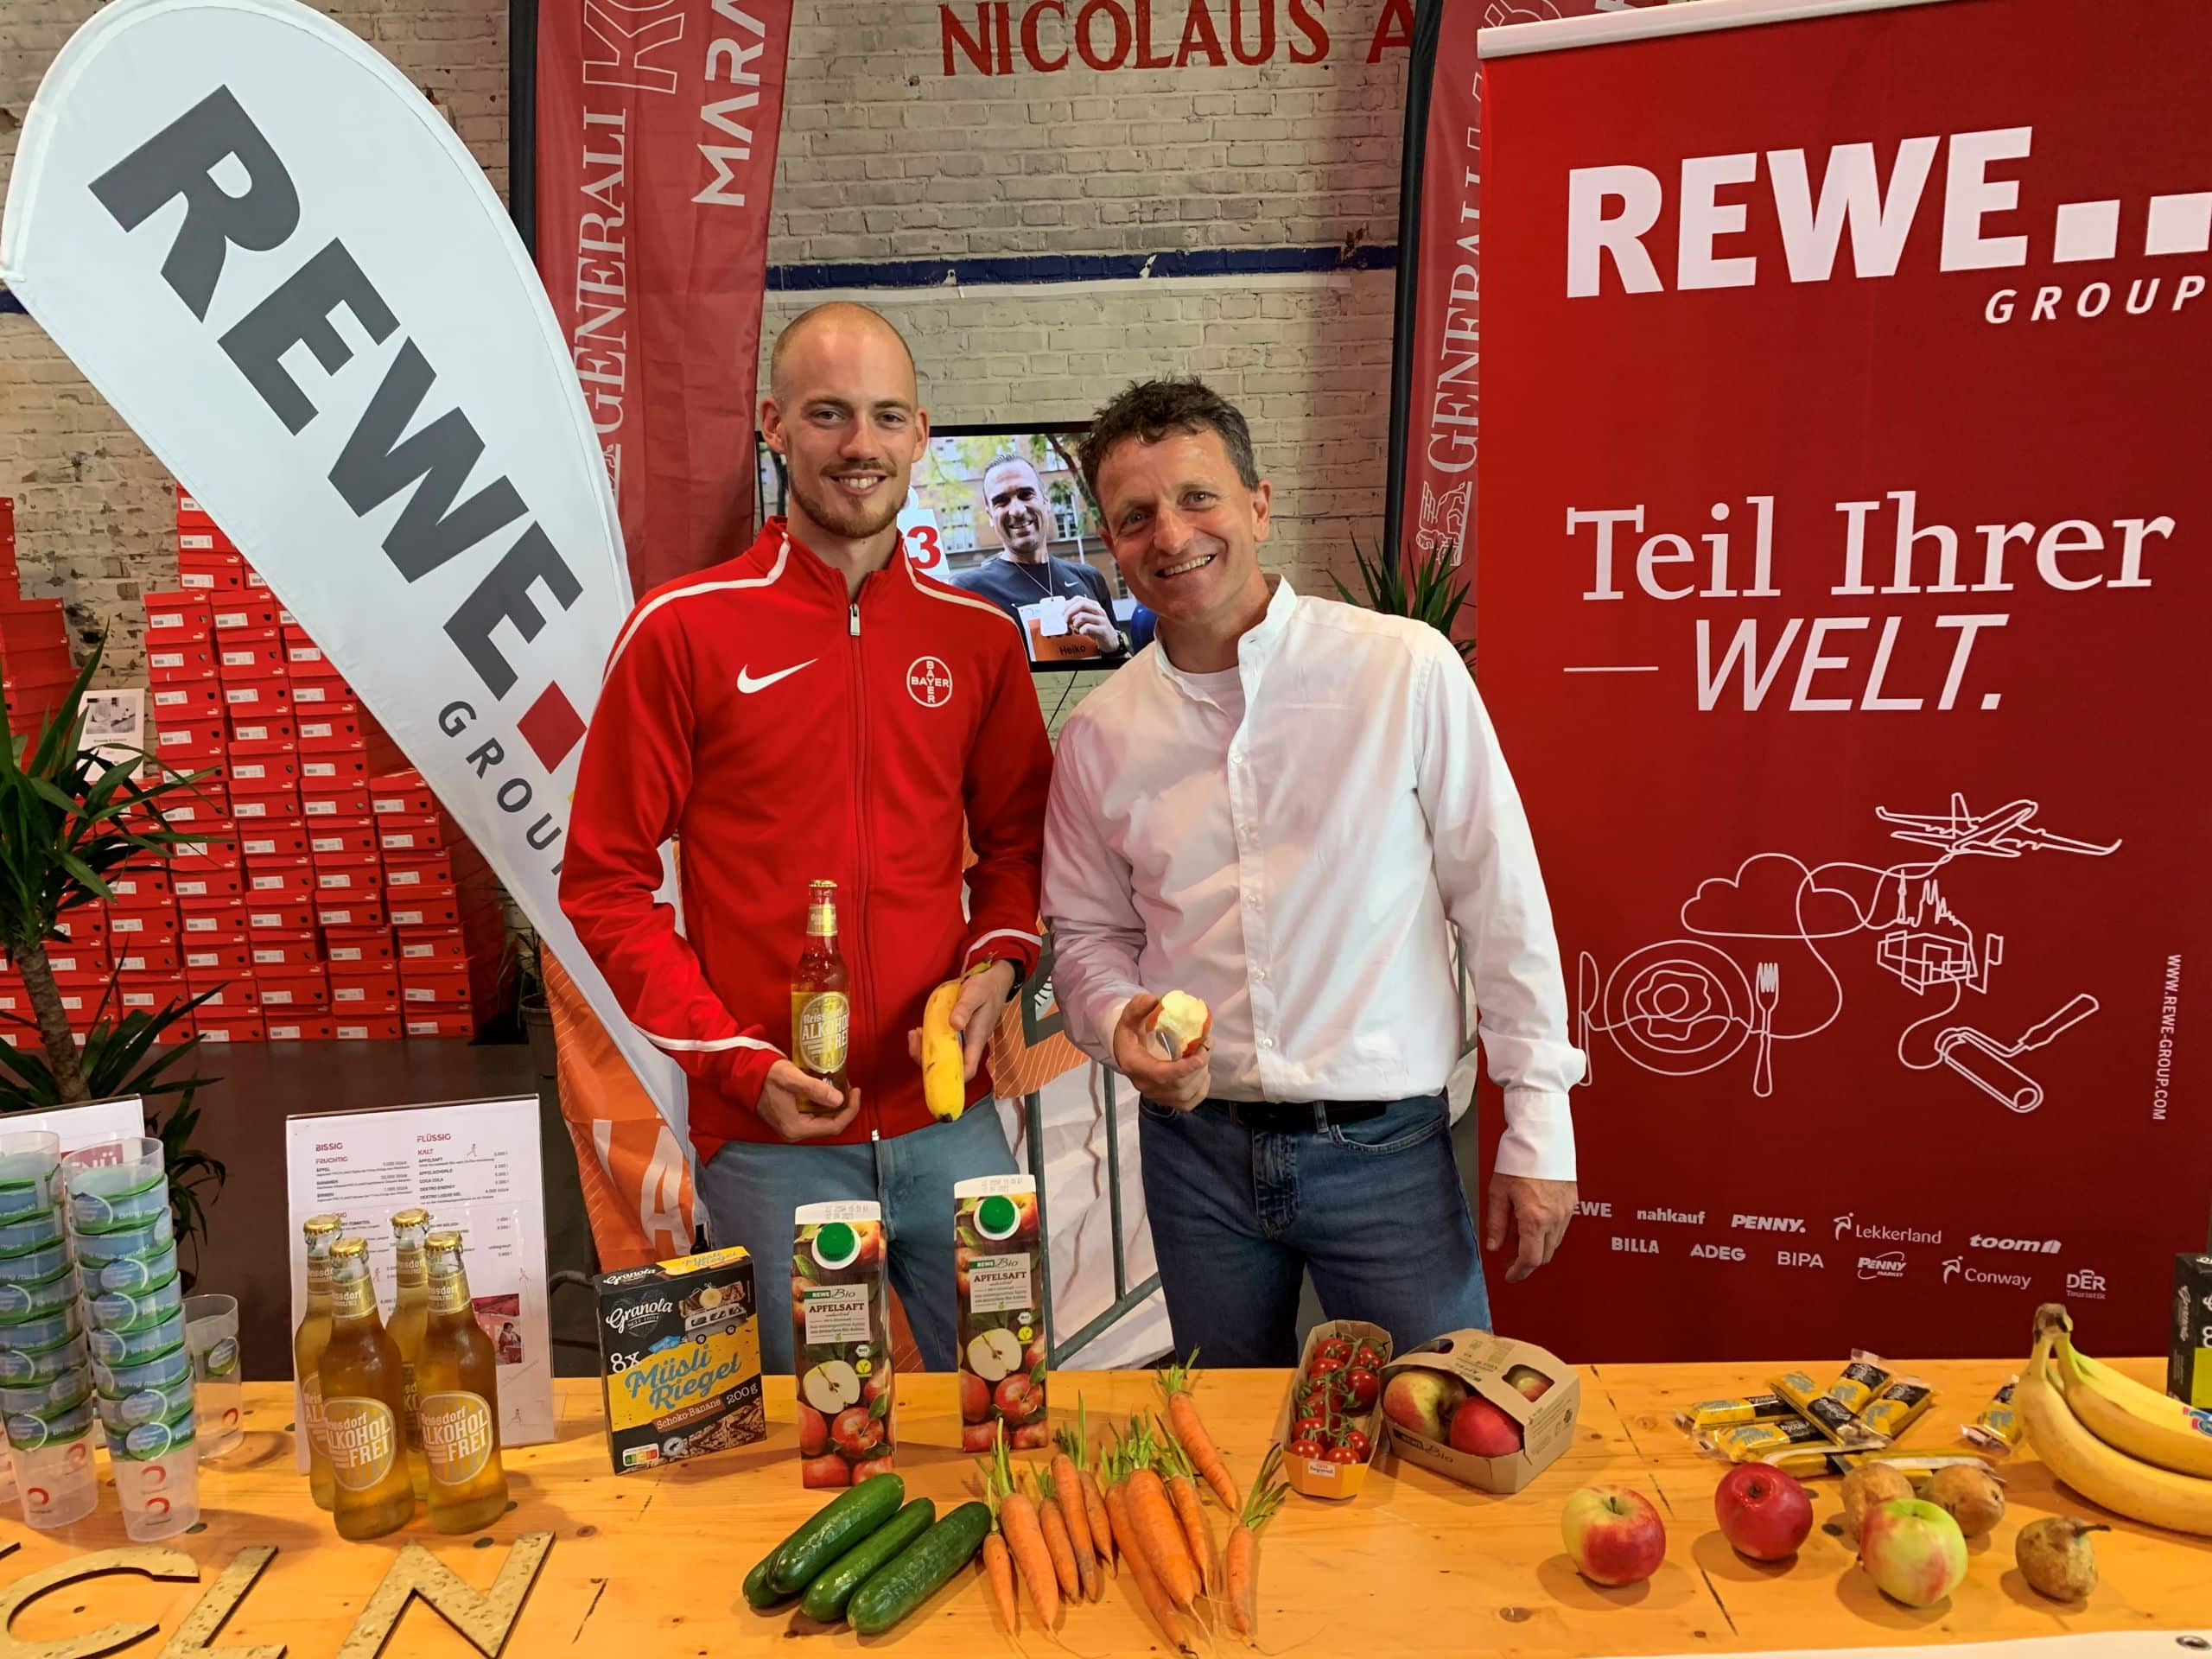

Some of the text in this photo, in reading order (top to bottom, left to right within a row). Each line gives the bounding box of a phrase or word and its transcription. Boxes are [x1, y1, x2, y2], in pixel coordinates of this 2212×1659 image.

[939, 0, 1331, 77] NICOLAUS
[574, 105, 627, 435] GENERALI
[1984, 275, 2207, 326] GROUP
[88, 84, 584, 702] REWE
[1566, 490, 2177, 602] Teil Ihrer
[1058, 645, 1086, 656] Heiko
[1694, 613, 2011, 713] WELT.
[911, 676, 950, 688] BAYER
[437, 701, 564, 876] GROU
[2152, 954, 2183, 1121] WWW.REWE-GROUP.COM
[315, 1142, 343, 1152] BISSIG
[416, 1133, 452, 1143] FLÜSSIG
[1637, 1208, 1707, 1225] nahkauf
[1855, 1224, 1942, 1245] Lekkerland
[1969, 1233, 2041, 1252] toom
[994, 1257, 1019, 1268] Bio
[1611, 1236, 1825, 1268] BILLA ADEG BIPA
[1858, 1256, 1907, 1272] PENNY
[602, 1267, 657, 1286] Granola
[974, 1271, 1027, 1283] APFELSAFT
[1964, 1268, 2032, 1290] Conway
[809, 1302, 865, 1313] APFELSAFT
[830, 1287, 856, 1300] Bio
[605, 1298, 673, 1334] Granola
[610, 1351, 641, 1374] 8x
[625, 1344, 712, 1400] Müsli
[648, 1351, 743, 1410] Riegel
[726, 1382, 759, 1406] 200g
[422, 1409, 488, 1444] ALKOHOL
[656, 1398, 721, 1431] Schoko-Banane
[349, 1440, 390, 1468] FREI
[448, 1427, 486, 1462] FREI
